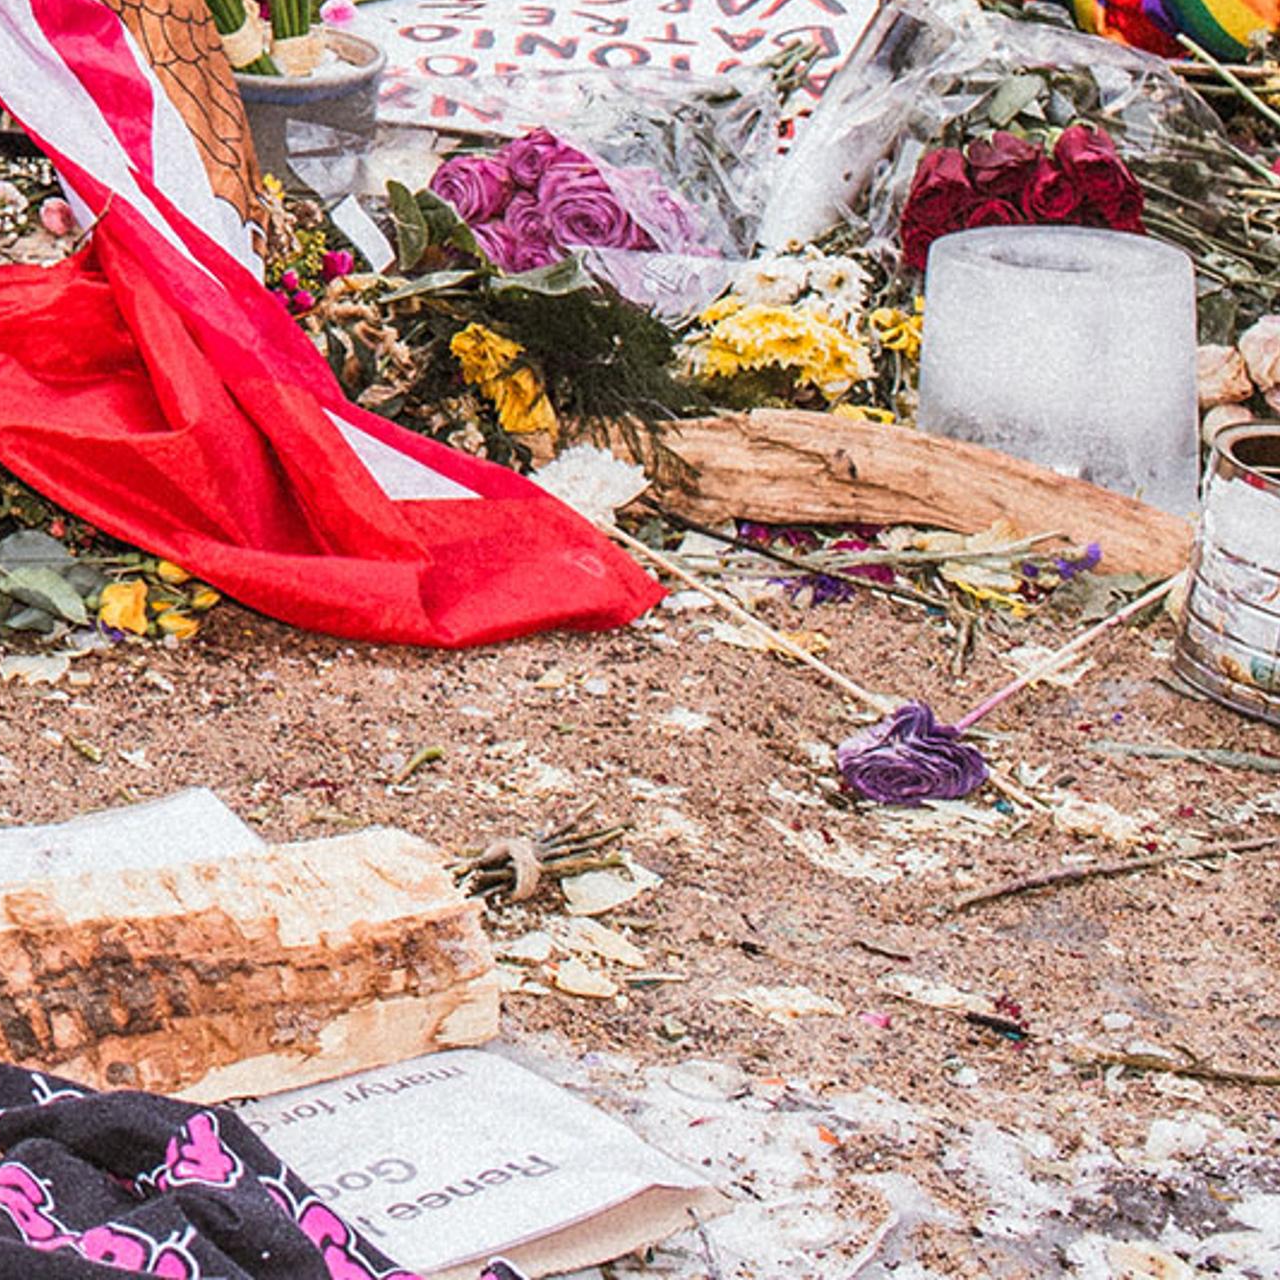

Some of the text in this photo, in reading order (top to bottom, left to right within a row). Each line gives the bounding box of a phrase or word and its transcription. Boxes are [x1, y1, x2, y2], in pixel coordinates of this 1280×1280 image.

[345, 1063, 466, 1106] martyr
[279, 1096, 338, 1126] for
[386, 1154, 560, 1222] Renee
